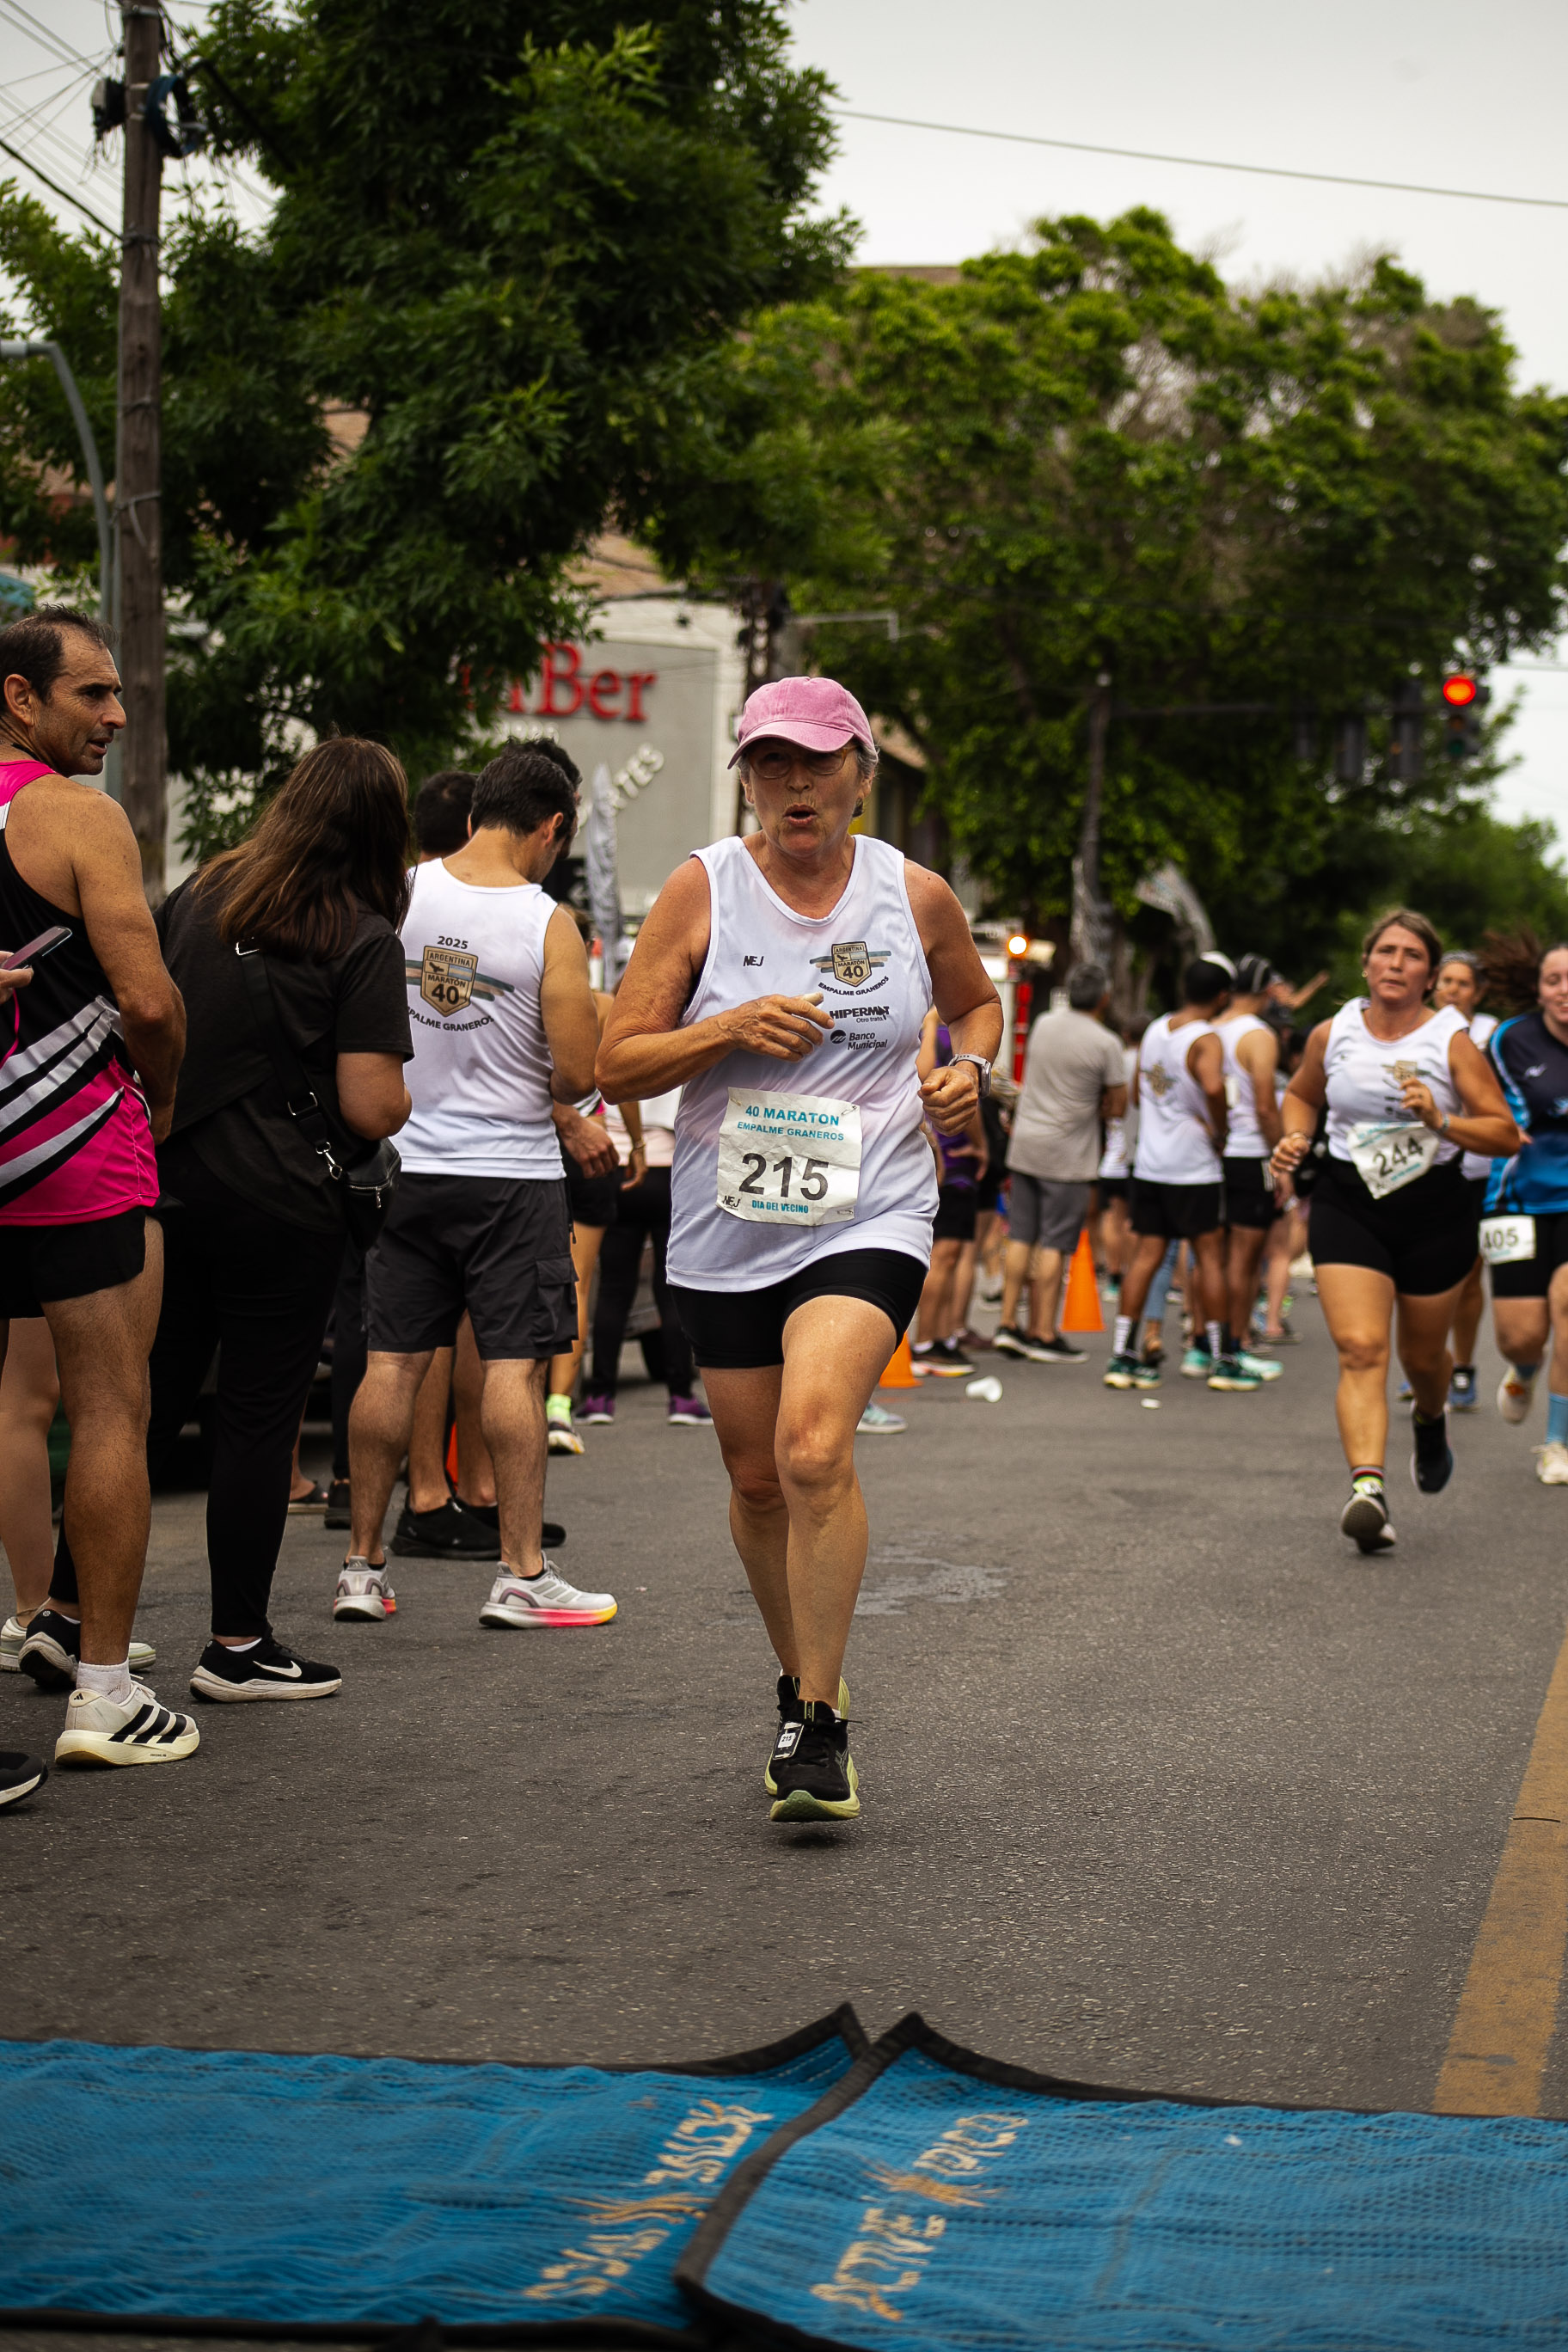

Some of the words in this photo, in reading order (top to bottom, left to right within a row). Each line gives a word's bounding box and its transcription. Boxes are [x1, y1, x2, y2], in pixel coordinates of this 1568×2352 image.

[437, 936, 469, 949] 2025
[429, 952, 470, 967] ARGENTINA
[743, 955, 764, 967] NEJ
[838, 959, 865, 967] MARATÓN
[843, 965, 864, 979] 40
[428, 974, 466, 988] MARATÓN
[818, 982, 854, 995] EMPALME
[855, 976, 889, 995] GRANEROS
[432, 983, 460, 1005] 40
[407, 1007, 441, 1029] PALME
[849, 1032, 875, 1041] Banco
[848, 1039, 888, 1050] Municipal
[745, 1106, 760, 1117] 40
[763, 1108, 840, 1126] MARATON
[737, 1121, 784, 1135] EMPALME
[787, 1128, 844, 1141] GRANEROS
[1373, 1136, 1424, 1177] 244
[738, 1153, 829, 1201] 215
[751, 1200, 764, 1210] DIA
[766, 1201, 779, 1211] DEL
[781, 1204, 809, 1213] VECINO
